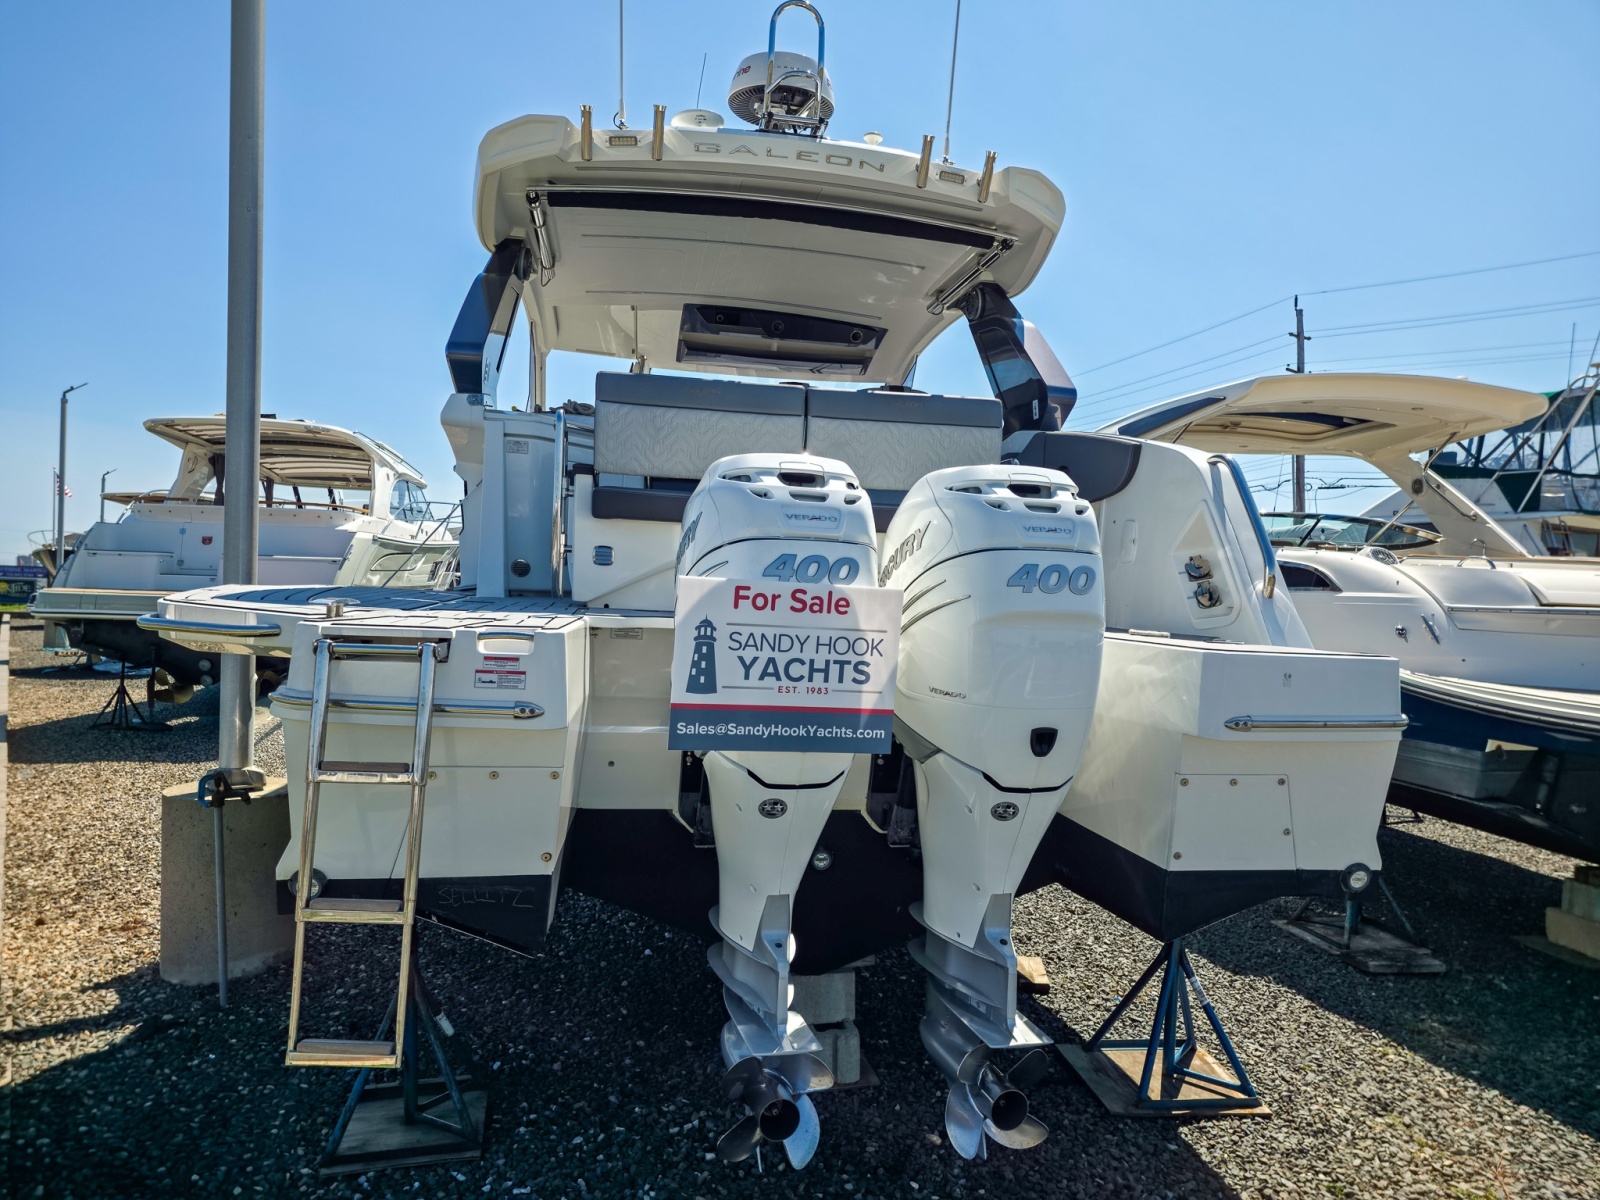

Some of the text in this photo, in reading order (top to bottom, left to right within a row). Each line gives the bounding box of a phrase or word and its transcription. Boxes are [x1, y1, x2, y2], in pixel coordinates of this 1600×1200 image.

[693, 142, 885, 173] GALEON
[785, 513, 838, 523] VERADO
[1022, 525, 1072, 535] VERADO
[877, 520, 932, 588] RCURY
[762, 553, 860, 585] 400
[1006, 563, 1096, 596] 400
[733, 585, 851, 615] For Sale
[728, 631, 884, 657] SANDY HOOK
[737, 655, 871, 685] YACHTS
[778, 685, 829, 695] EST. 1983
[929, 686, 967, 699] VERADO
[676, 722, 885, 740] Sales@SandyHookYachts.com
